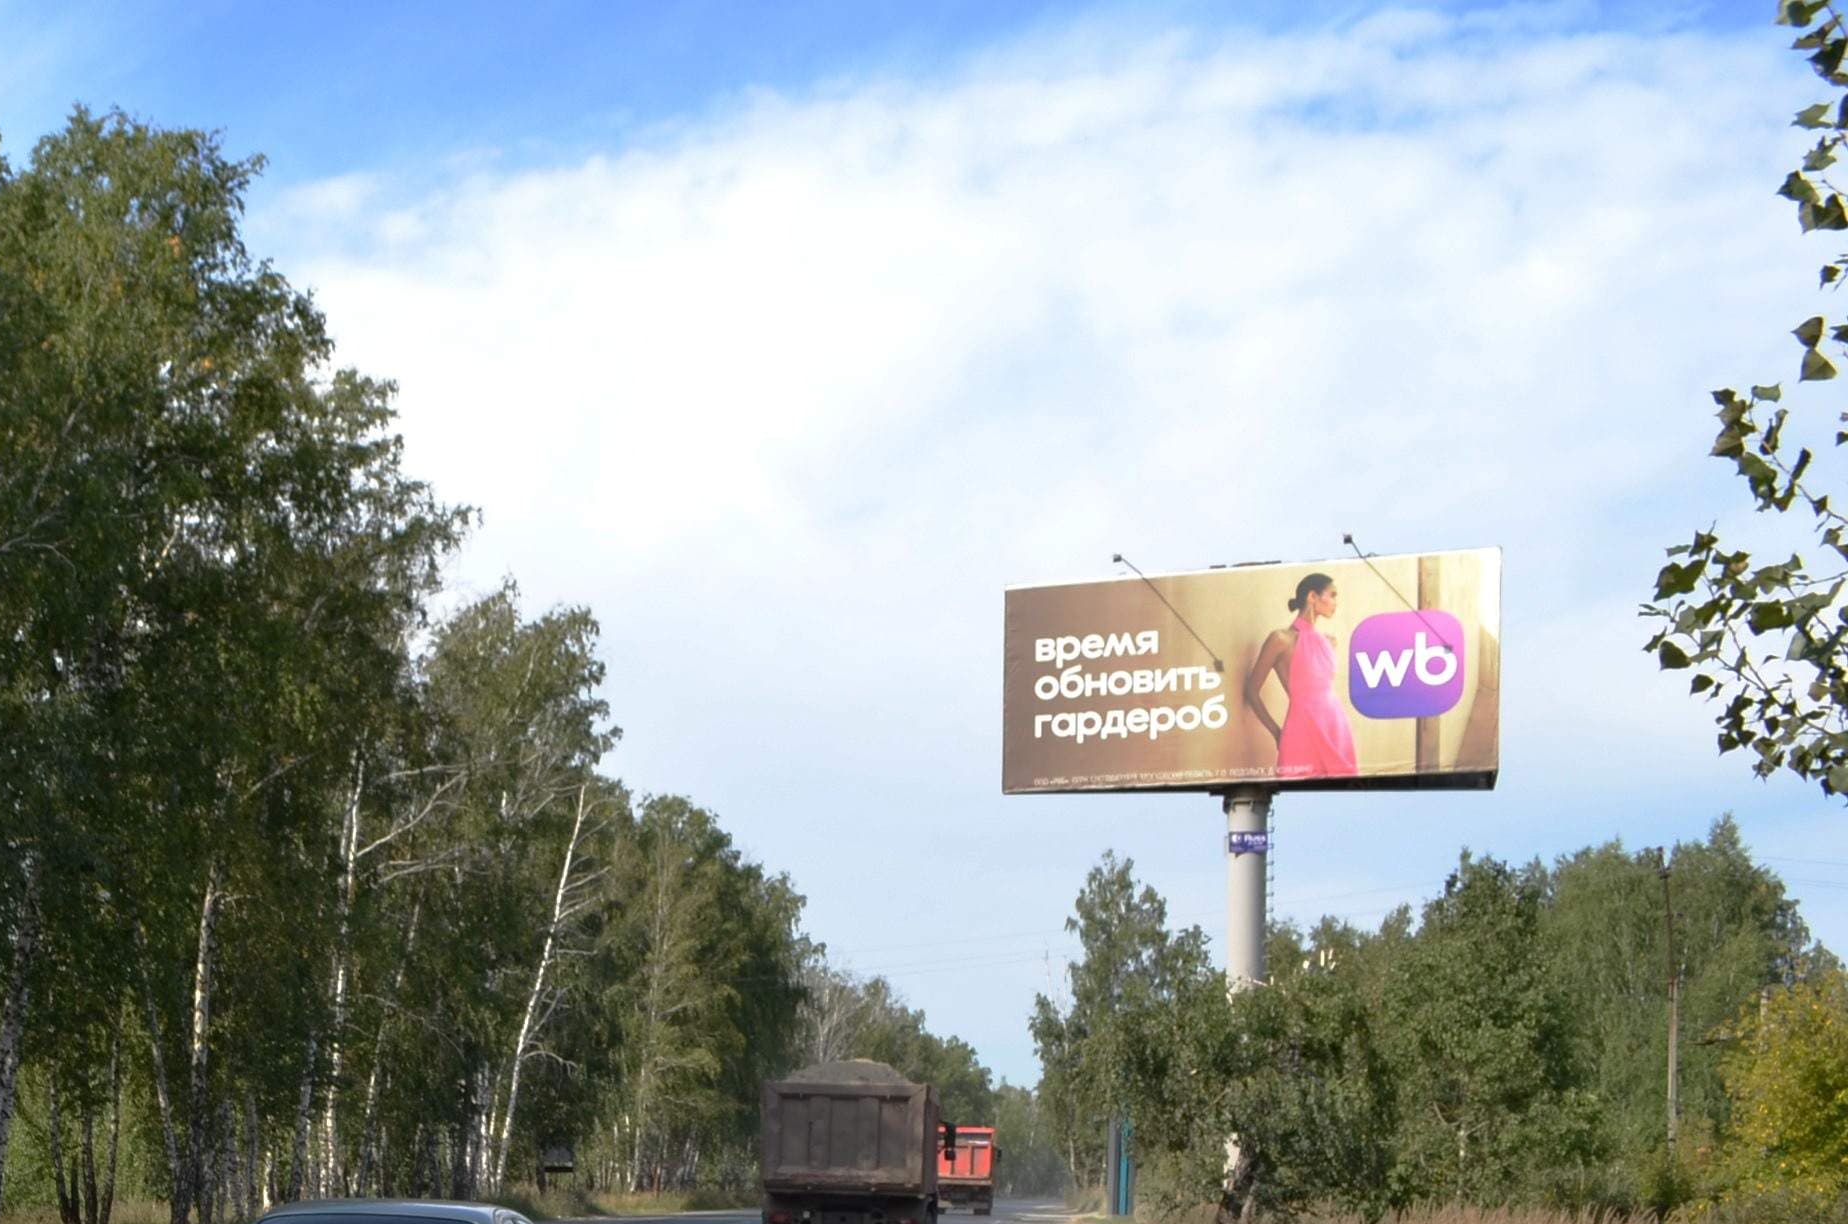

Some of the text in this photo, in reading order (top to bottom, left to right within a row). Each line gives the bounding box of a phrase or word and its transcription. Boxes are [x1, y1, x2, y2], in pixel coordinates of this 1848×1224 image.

[1035, 631, 1159, 668] время
[1355, 631, 1458, 689] wb
[1034, 665, 1221, 700] обновить
[1034, 694, 1228, 744] гардероб
